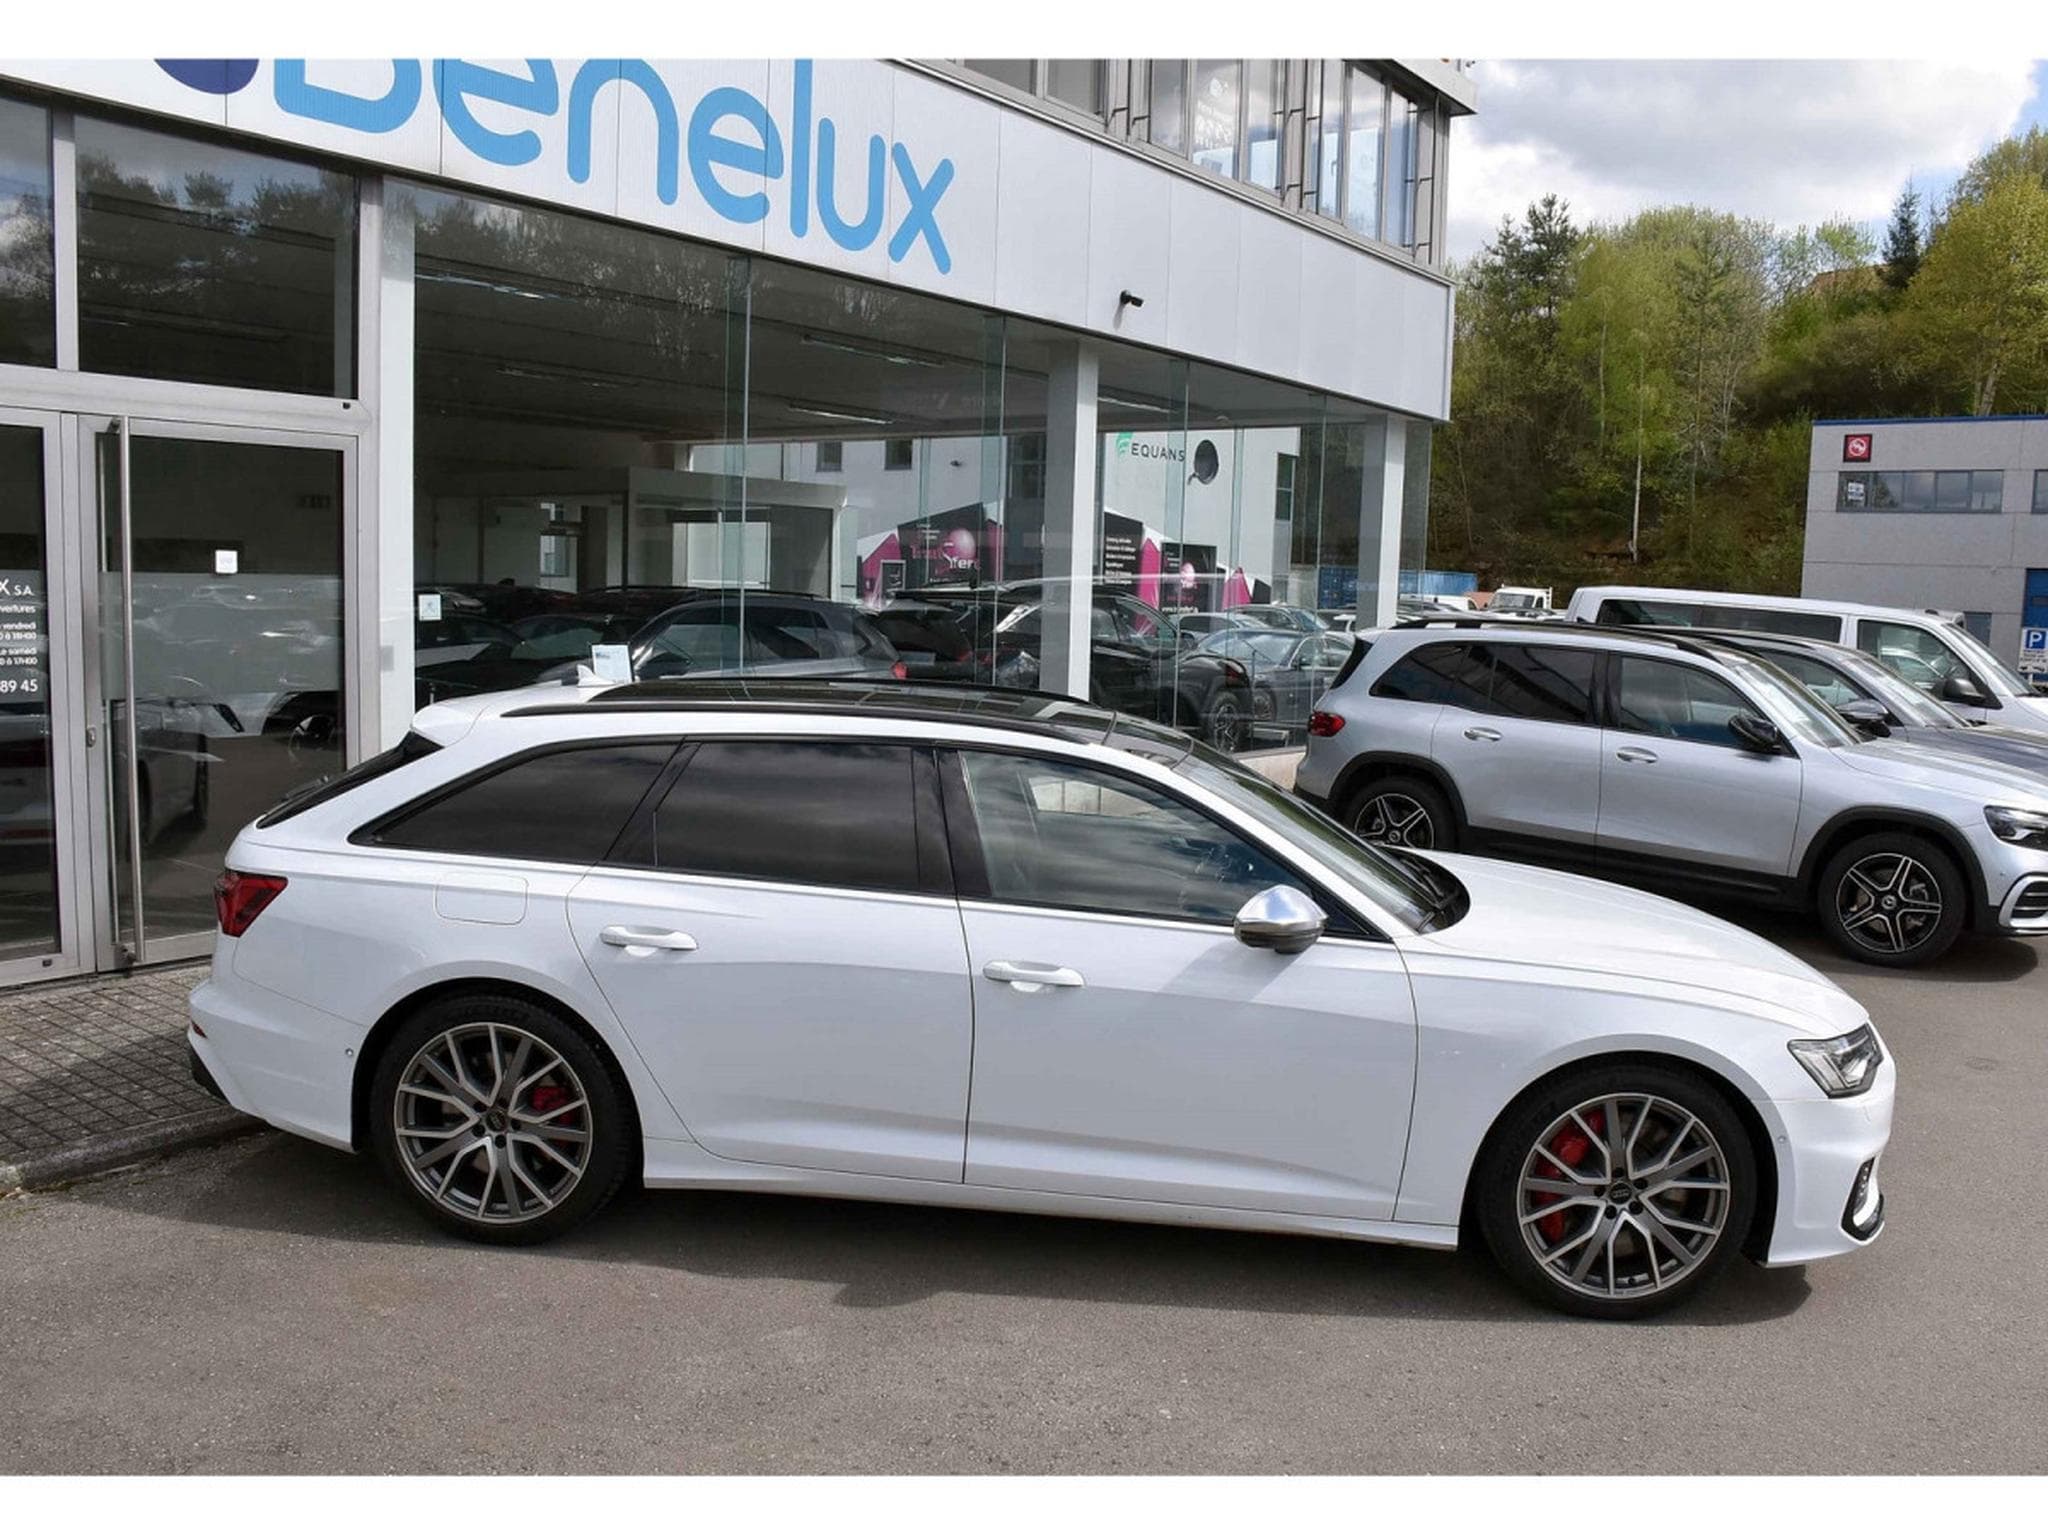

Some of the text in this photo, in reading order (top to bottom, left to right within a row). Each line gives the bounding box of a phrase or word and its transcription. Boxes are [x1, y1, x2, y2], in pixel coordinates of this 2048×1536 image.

[1131, 443, 1185, 462] EQUANS
[2029, 631, 2042, 648] P
[0, 679, 38, 693] 89 45
